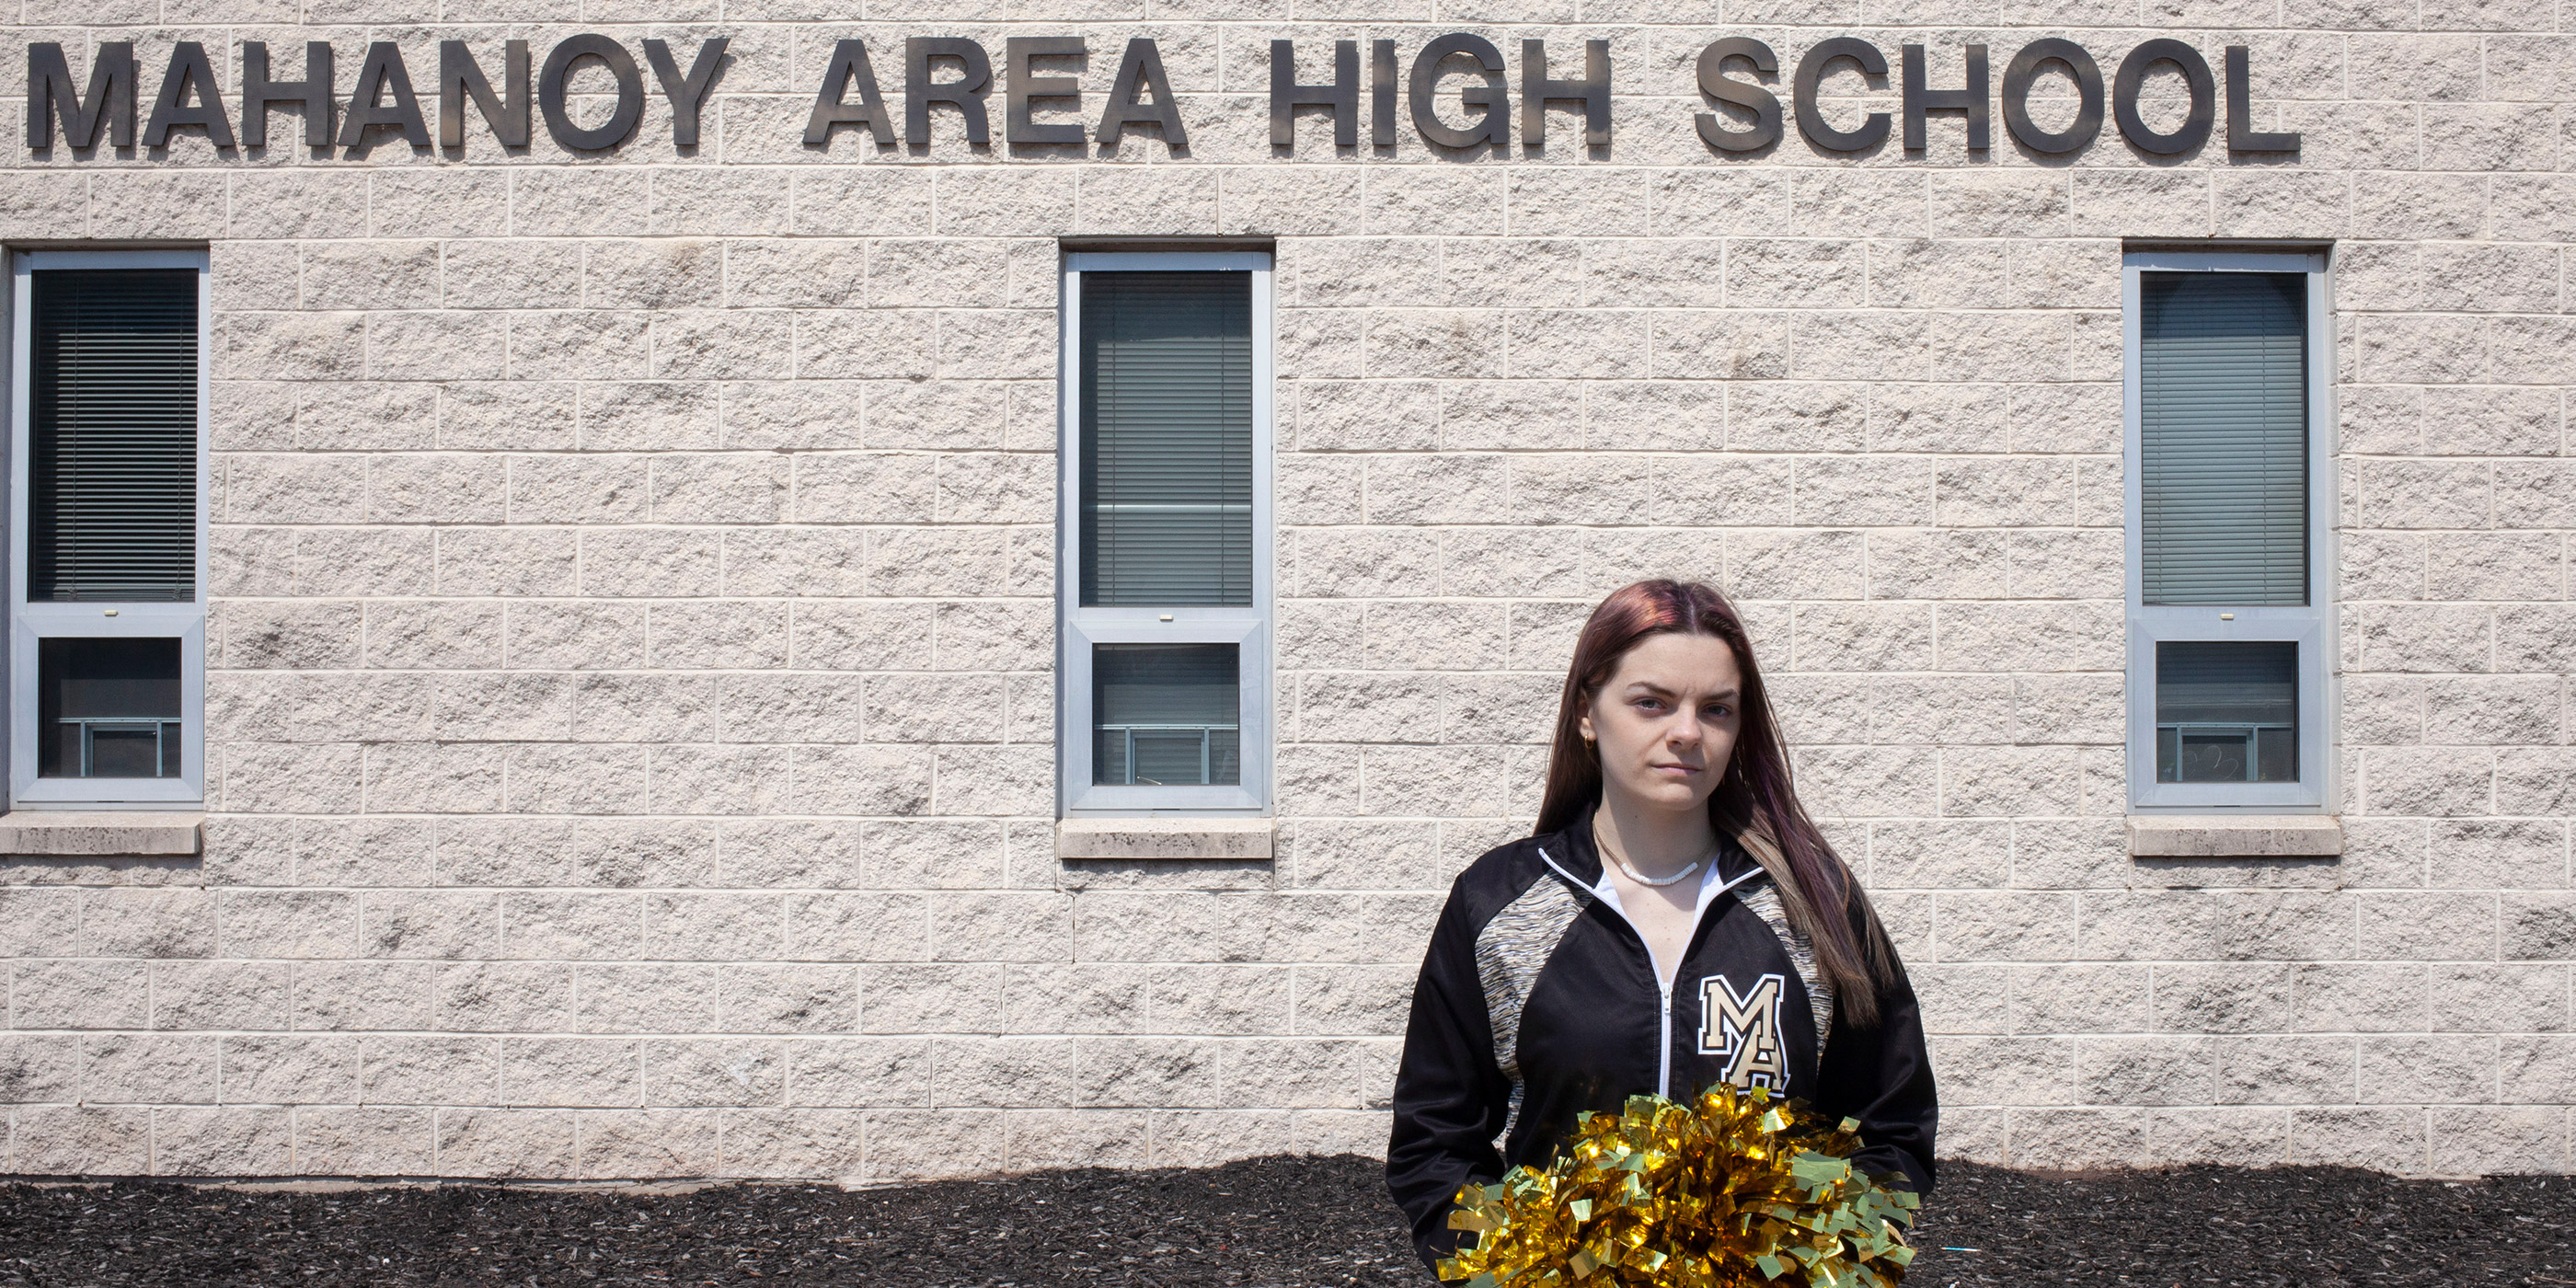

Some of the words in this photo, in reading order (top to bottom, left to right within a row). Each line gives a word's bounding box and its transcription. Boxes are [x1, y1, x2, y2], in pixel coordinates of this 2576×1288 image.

[27, 33, 731, 150] MAHANOY
[802, 37, 1188, 145] AREA
[1271, 32, 1611, 148] HIGH
[1695, 36, 2301, 155] SCHOOL
[1698, 973, 1790, 1098] MA
